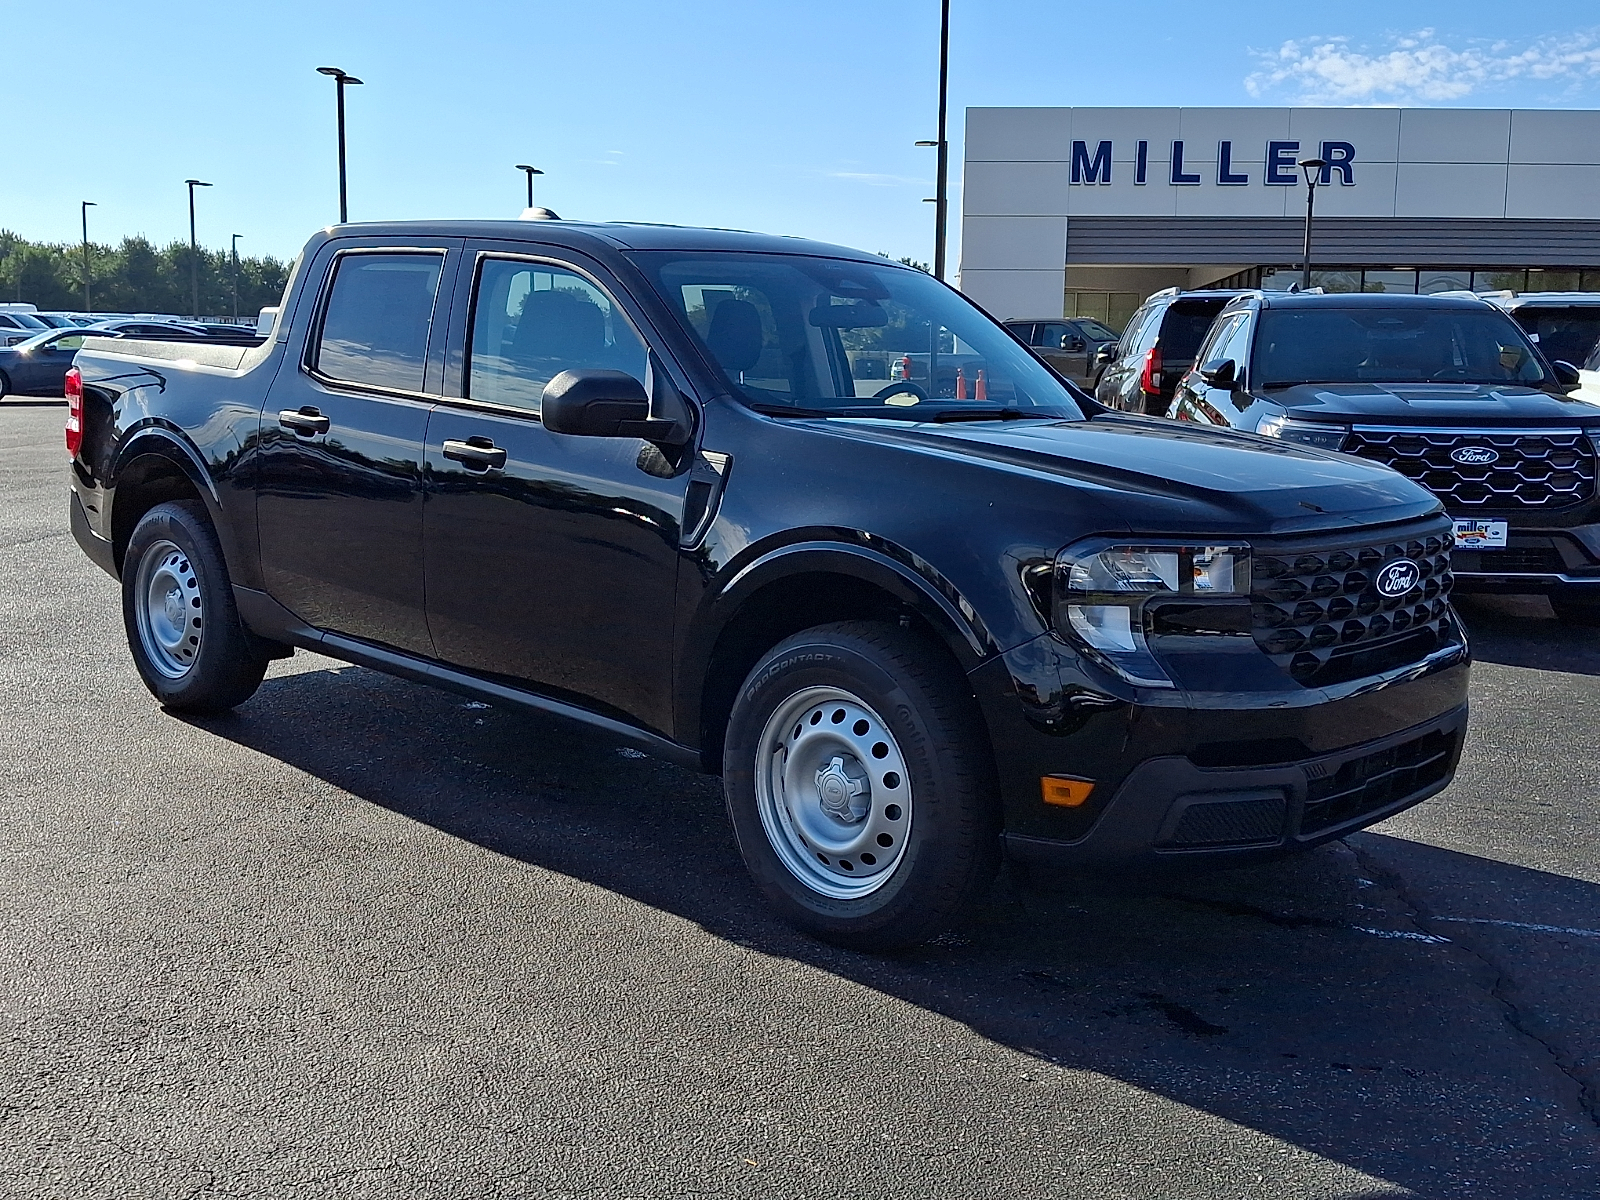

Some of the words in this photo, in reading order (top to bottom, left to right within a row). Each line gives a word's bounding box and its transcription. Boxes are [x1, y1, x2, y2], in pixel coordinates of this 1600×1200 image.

[1070, 139, 1356, 185] MILLER
[1459, 449, 1490, 461] Ford
[1457, 521, 1490, 532] miller
[1385, 566, 1413, 592] Ford
